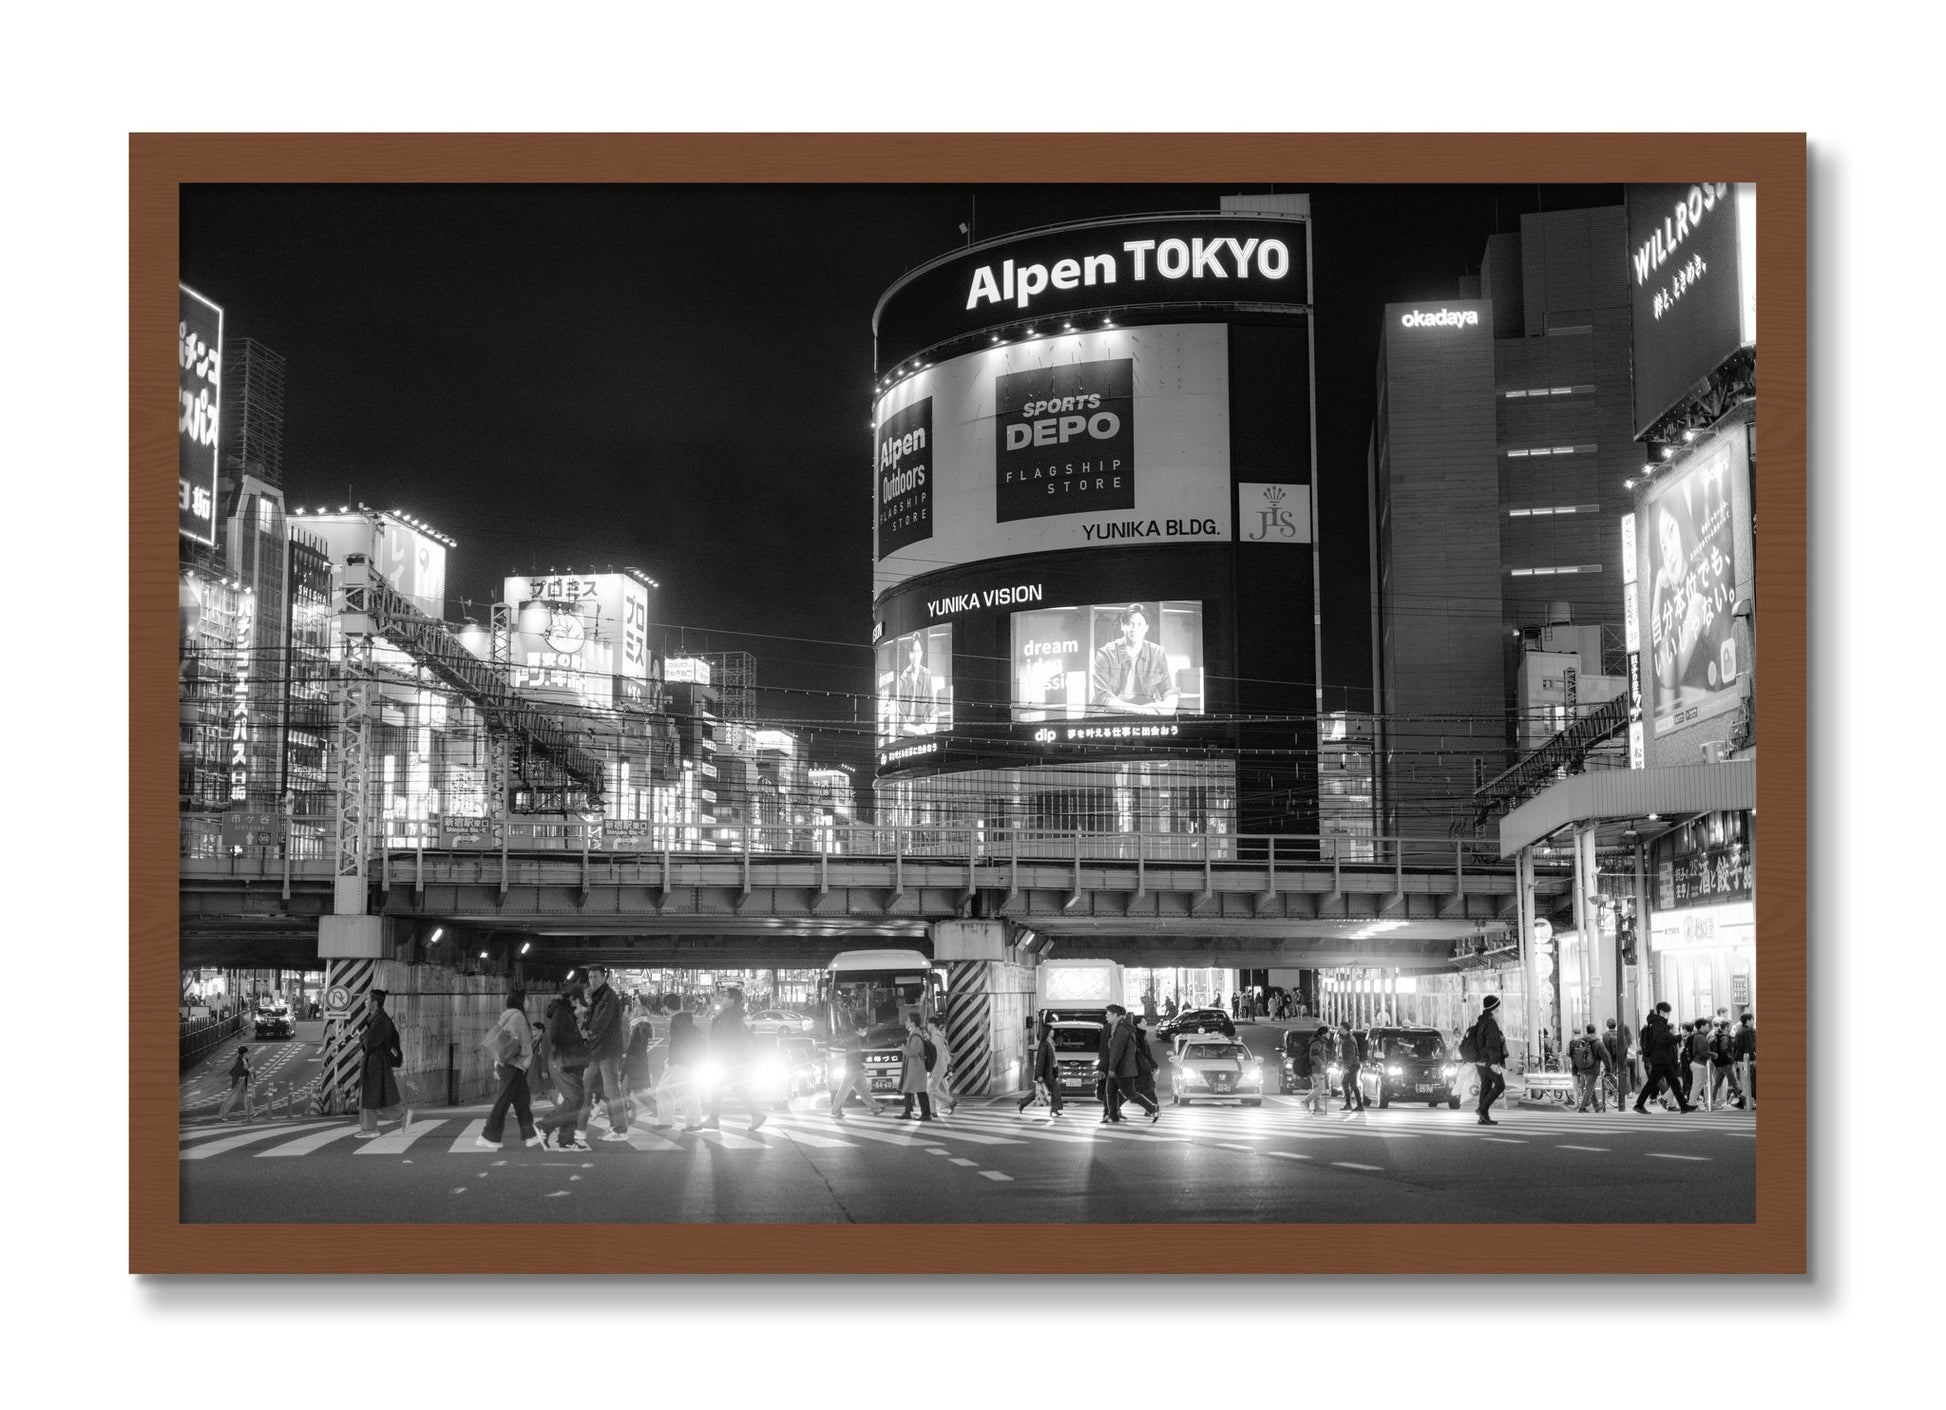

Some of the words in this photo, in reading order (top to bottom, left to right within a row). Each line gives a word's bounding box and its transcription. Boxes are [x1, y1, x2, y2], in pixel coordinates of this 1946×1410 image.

[965, 251, 1117, 311] Alpen
[1123, 237, 1289, 281] TOKYO
[1402, 308, 1478, 328] okadaya
[1022, 393, 1101, 418] SPORTS
[179, 388, 217, 448] スパス
[1006, 411, 1120, 451] DEPO
[880, 427, 925, 472] Alpen
[1006, 459, 1121, 483] FLAGSHIP
[883, 464, 925, 504] Outdoors
[1047, 477, 1121, 494] STORE
[880, 492, 926, 525] FLAGSHIP
[893, 508, 926, 532] STORE
[1083, 521, 1160, 541] YUNIKA
[1166, 519, 1221, 537] BLDG.
[298, 584, 327, 604] SHISHA
[530, 580, 598, 598] プロミス
[927, 592, 980, 617] YUNIKA
[983, 584, 1042, 605] VISION
[1024, 639, 1079, 656] dream
[1035, 729, 1056, 743] dip
[1067, 725, 1178, 739] 夢を叶える仕事に出会おう
